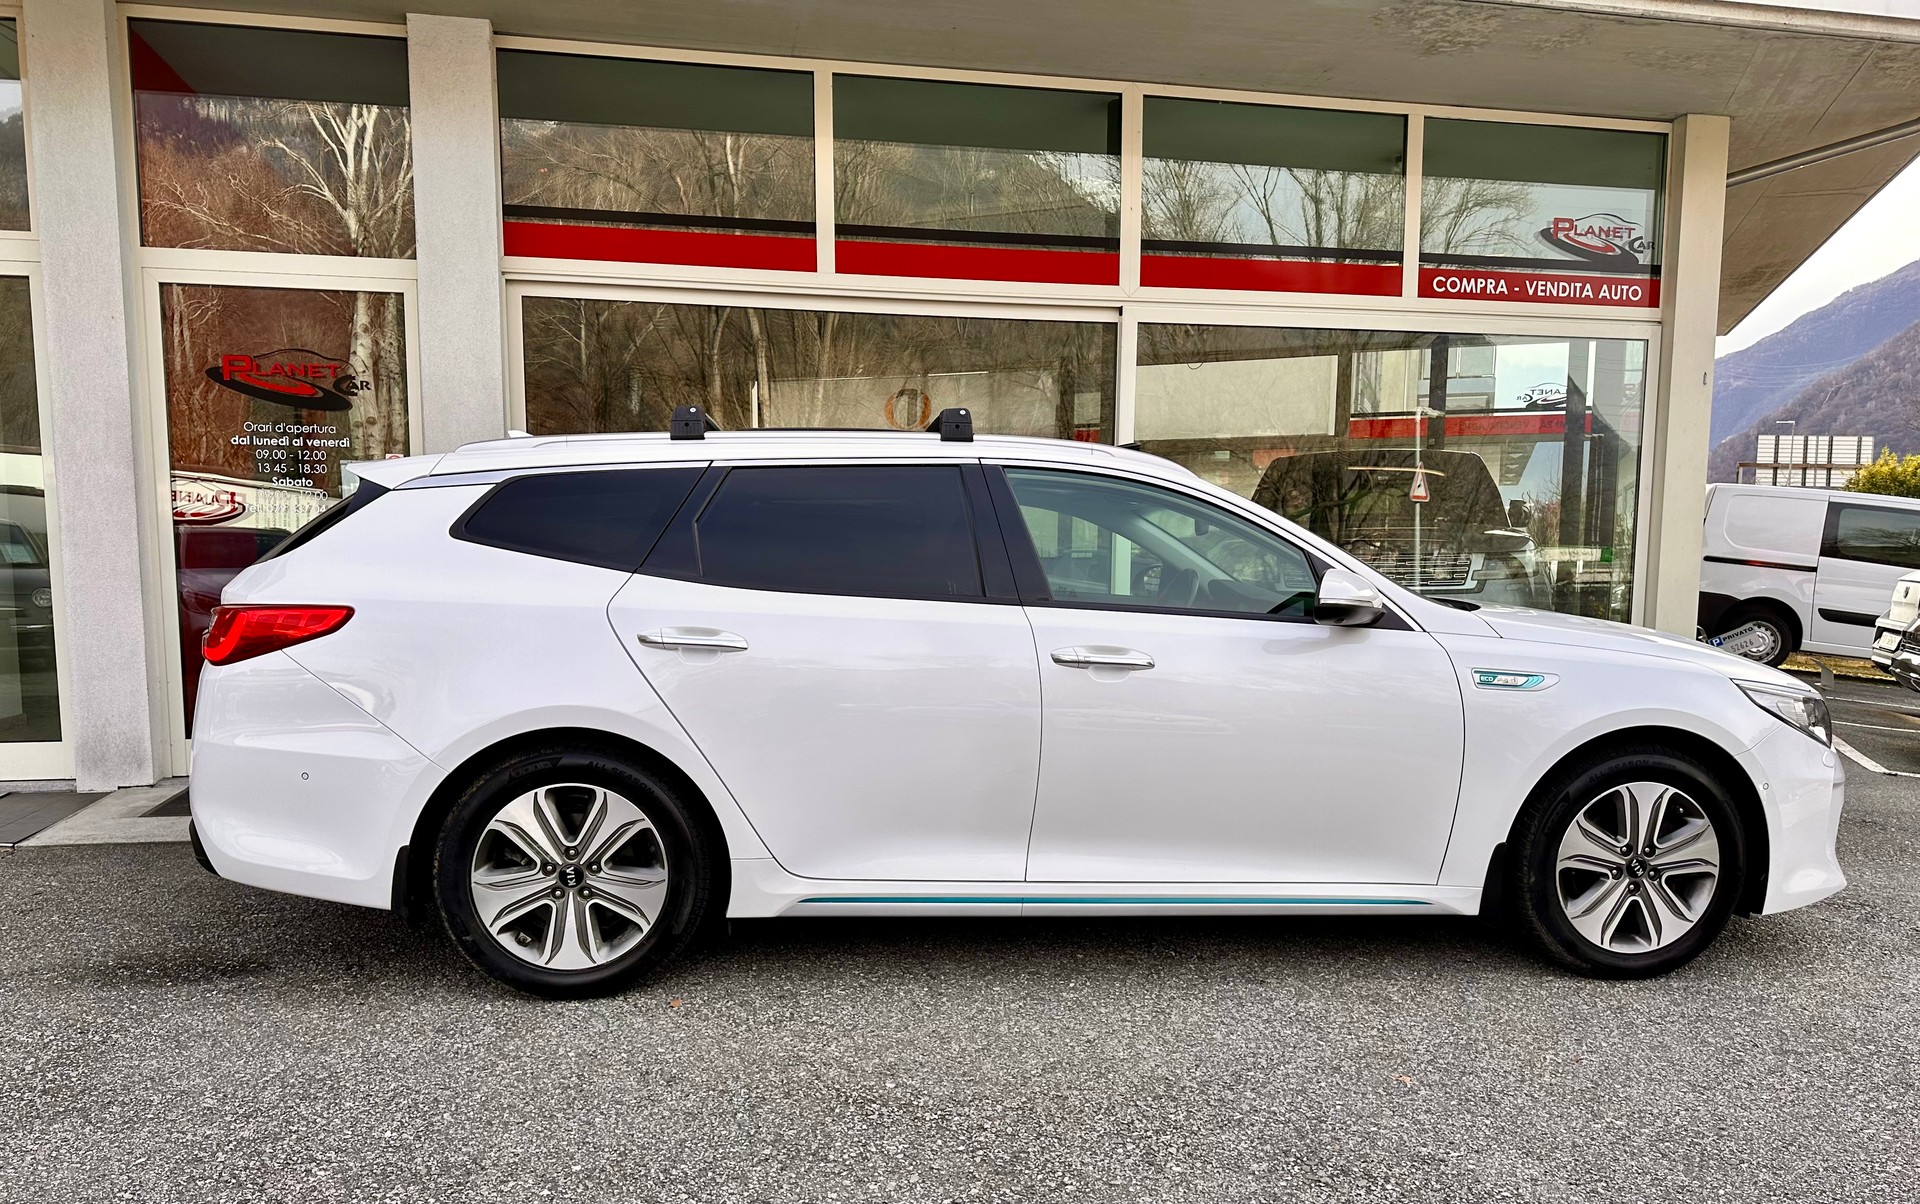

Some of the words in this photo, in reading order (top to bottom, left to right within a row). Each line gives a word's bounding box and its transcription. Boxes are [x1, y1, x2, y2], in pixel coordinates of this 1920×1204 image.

[1552, 217, 1636, 240] PLANET
[1628, 235, 1656, 254] CAR
[1432, 276, 1508, 294] COMPRA
[1525, 280, 1594, 299] VENDITA
[1598, 285, 1642, 301] AUTO
[221, 354, 341, 381] PLANET
[333, 375, 371, 396] CAR
[243, 421, 272, 432] Orari
[275, 422, 336, 434] d'apertura
[231, 435, 250, 445] dal
[252, 435, 289, 447] lunedì
[292, 437, 304, 447] al
[307, 436, 350, 448] venerdì
[255, 449, 287, 461] 09.00
[298, 451, 327, 462] 12.00
[299, 464, 327, 475] 18.30
[272, 476, 313, 488] Sabato
[1723, 626, 1754, 641] PRIVATO
[1712, 638, 1719, 647] P
[566, 866, 575, 886] KIA
[1631, 859, 1644, 877] KIA
